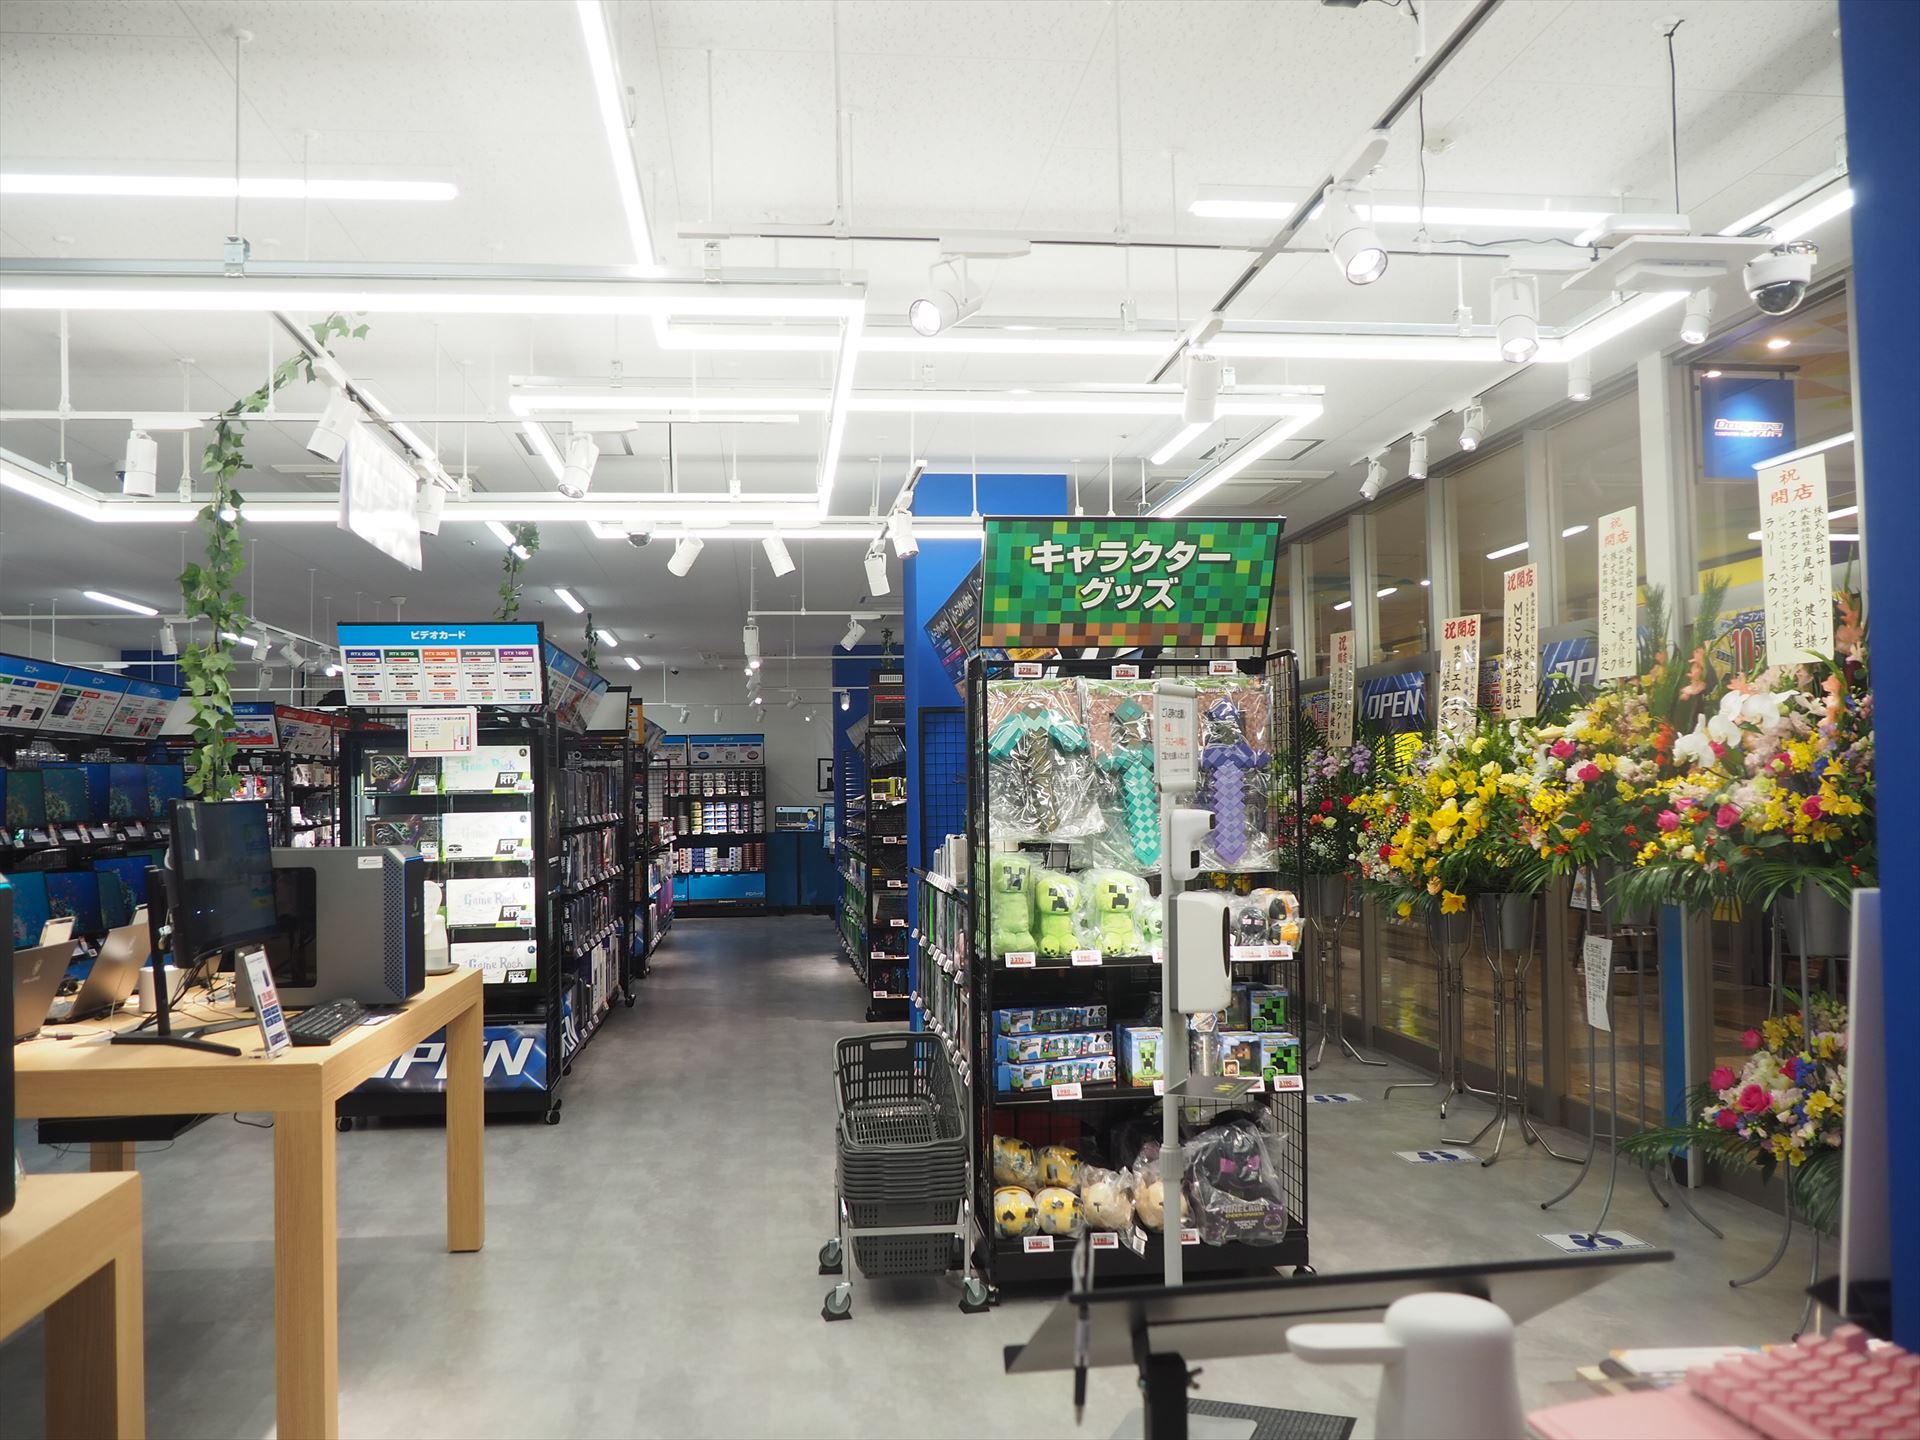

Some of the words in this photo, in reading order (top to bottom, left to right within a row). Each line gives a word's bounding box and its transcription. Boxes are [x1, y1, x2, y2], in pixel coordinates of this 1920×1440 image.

[1779, 468, 1800, 485] 祝
[1770, 483, 1814, 506] 開店
[1030, 540, 1232, 574] キャラクター
[1080, 576, 1180, 610] グッズ
[410, 630, 467, 640] ビデオカード
[1444, 619, 1477, 640] 祝開店
[1369, 688, 1422, 720] OPEN
[467, 957, 498, 971] Game
[499, 955, 524, 969] Rock
